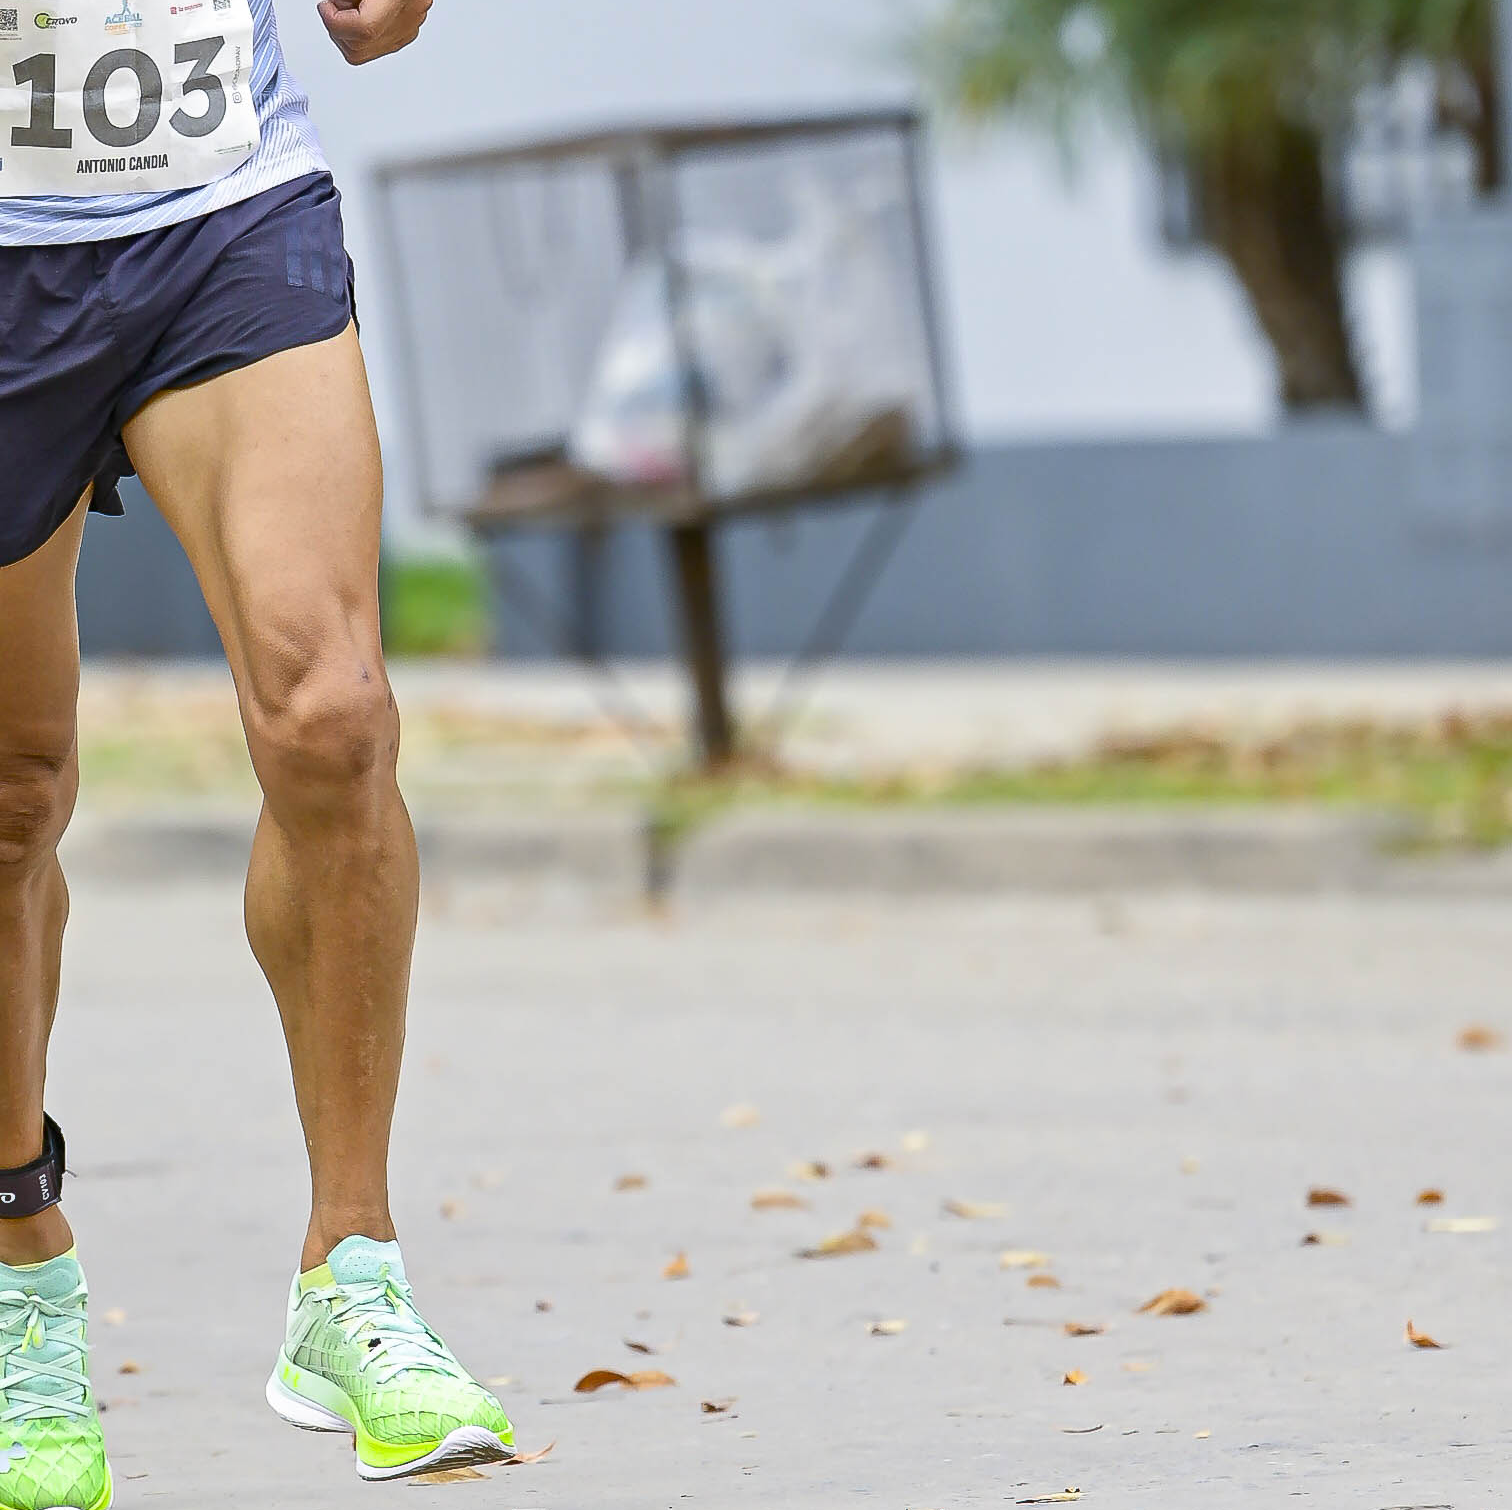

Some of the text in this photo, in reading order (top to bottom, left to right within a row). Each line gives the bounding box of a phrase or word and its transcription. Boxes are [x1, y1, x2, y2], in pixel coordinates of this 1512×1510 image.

[11, 35, 227, 149] 103
[76, 154, 169, 173] ANTONIO CANDIA
